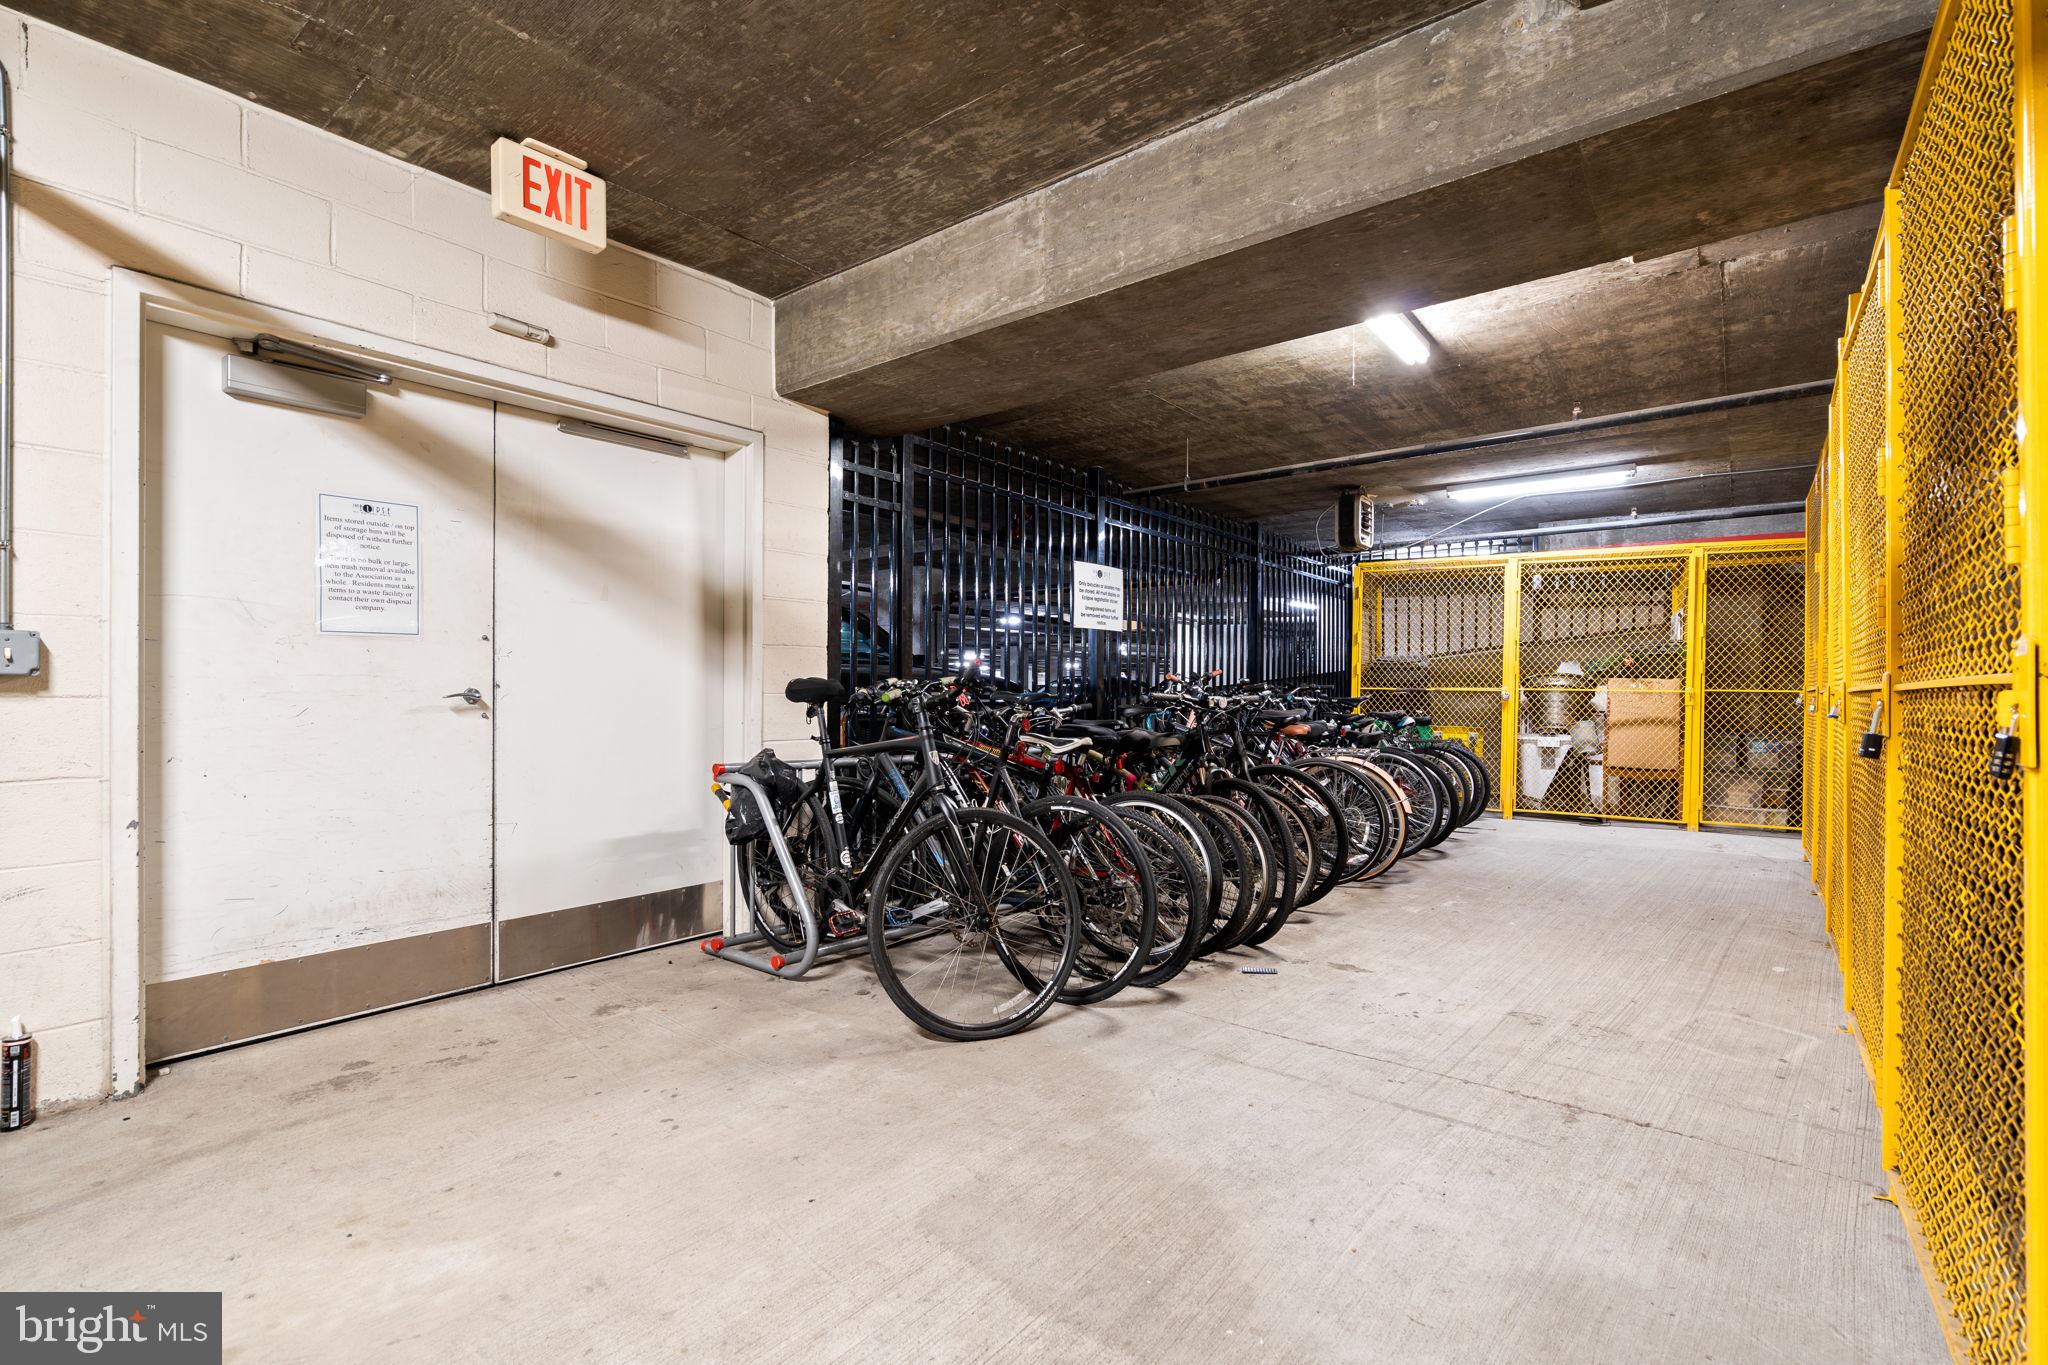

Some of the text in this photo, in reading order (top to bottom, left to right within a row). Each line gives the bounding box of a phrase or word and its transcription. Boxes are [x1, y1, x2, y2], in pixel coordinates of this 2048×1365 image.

[523, 154, 592, 231] EXIT
[344, 518, 365, 526] stored
[366, 520, 390, 528] outside
[343, 526, 368, 534] storage
[326, 531, 356, 540] disposed
[391, 538, 413, 546] further
[367, 557, 383, 565] bulk
[359, 565, 386, 573] removal
[386, 567, 415, 575] available
[355, 572, 393, 580] Association
[352, 580, 384, 588] Residents
[382, 589, 404, 597] facility
[386, 597, 412, 605] disposal
